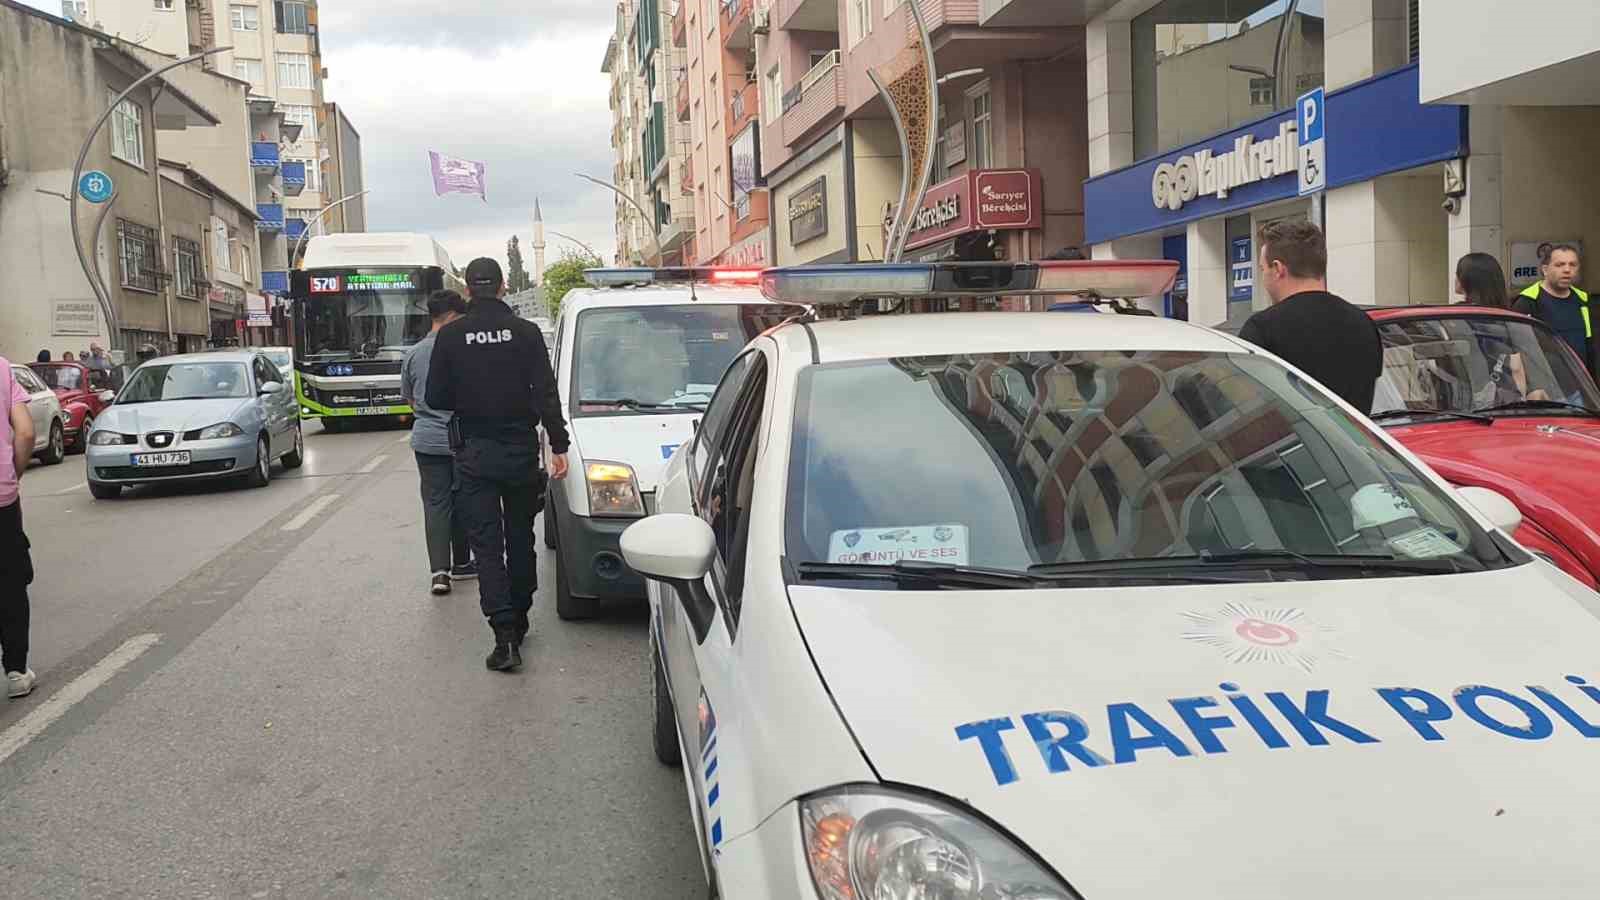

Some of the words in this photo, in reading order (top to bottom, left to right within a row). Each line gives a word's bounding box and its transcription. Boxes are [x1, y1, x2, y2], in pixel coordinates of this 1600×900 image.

[1303, 98, 1316, 141] P
[314, 277, 337, 290] 570
[465, 329, 512, 345] POLIS
[139, 454, 150, 464] 41
[170, 452, 188, 463] 736
[910, 549, 928, 559] VE
[954, 682, 1382, 786] TRAFİK
